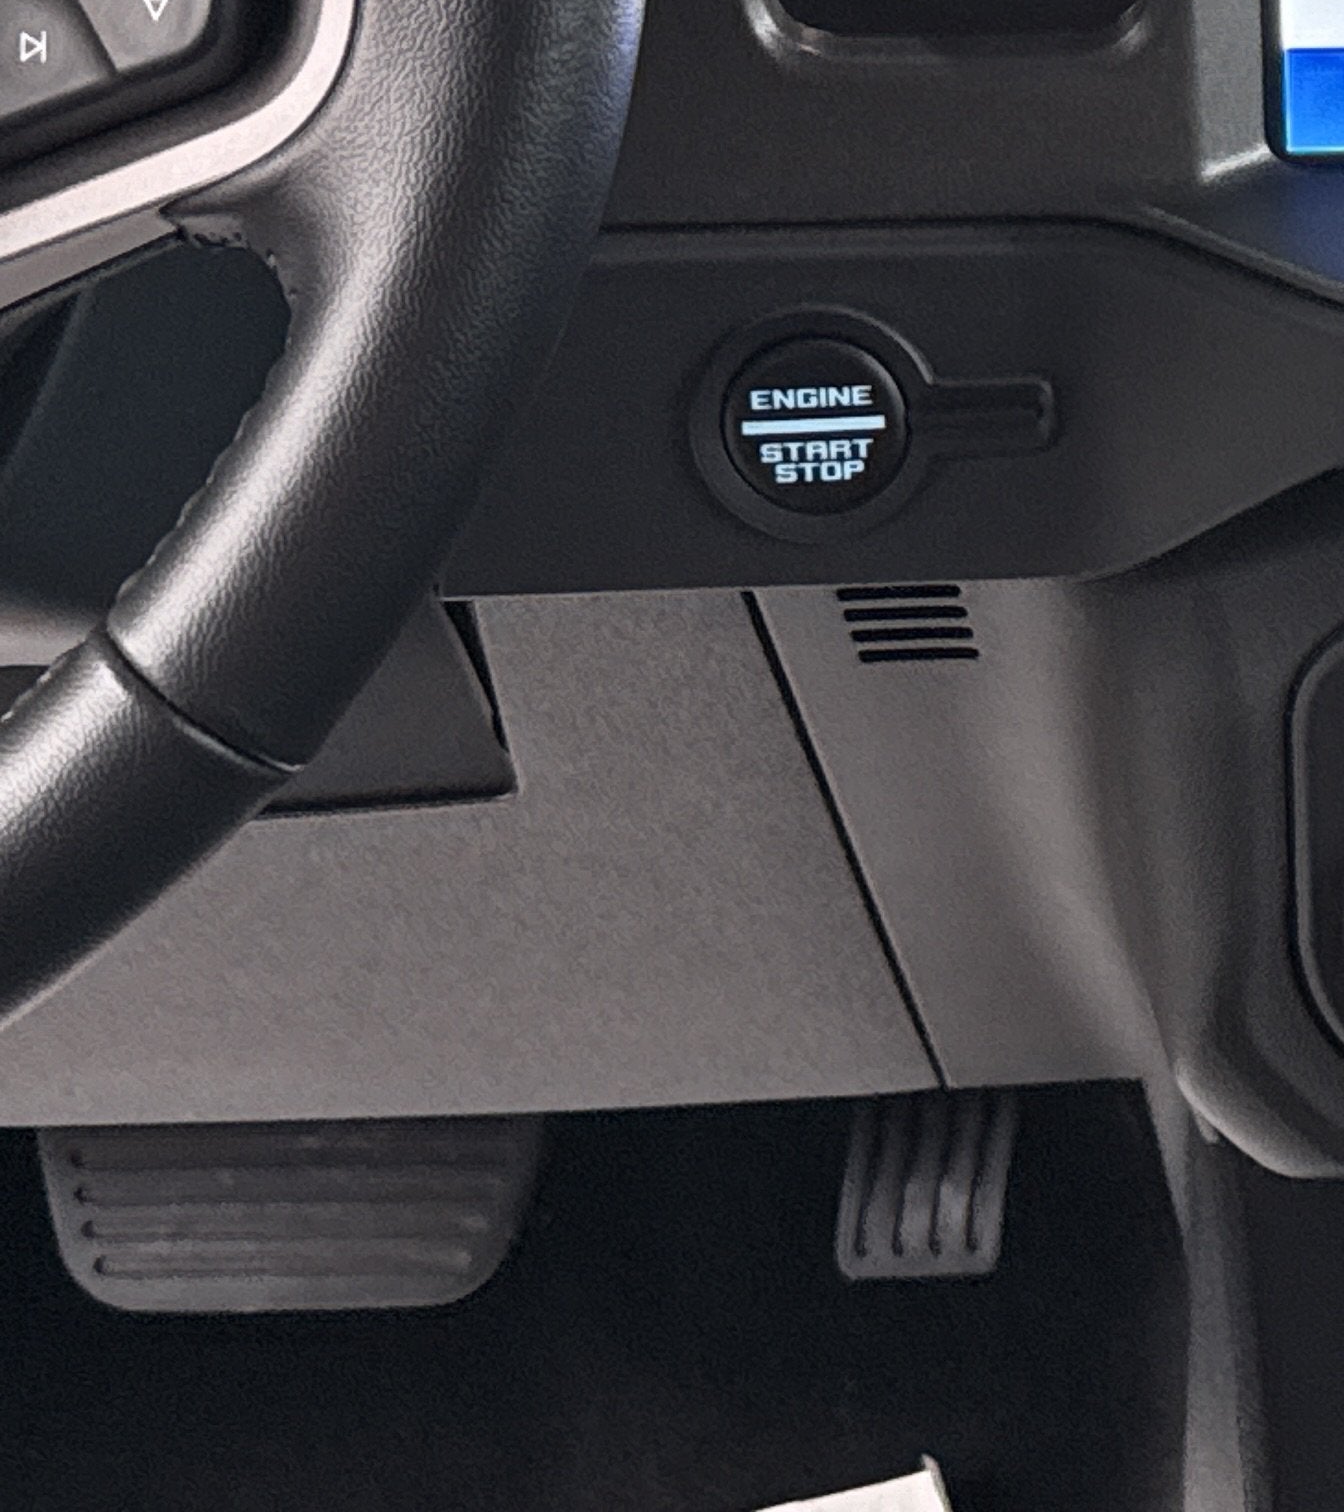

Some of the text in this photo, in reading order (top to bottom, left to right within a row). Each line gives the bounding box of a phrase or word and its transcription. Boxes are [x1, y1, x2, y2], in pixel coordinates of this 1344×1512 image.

[750, 384, 874, 410] ENGINE
[760, 438, 874, 464] START
[775, 460, 865, 484] STOP
